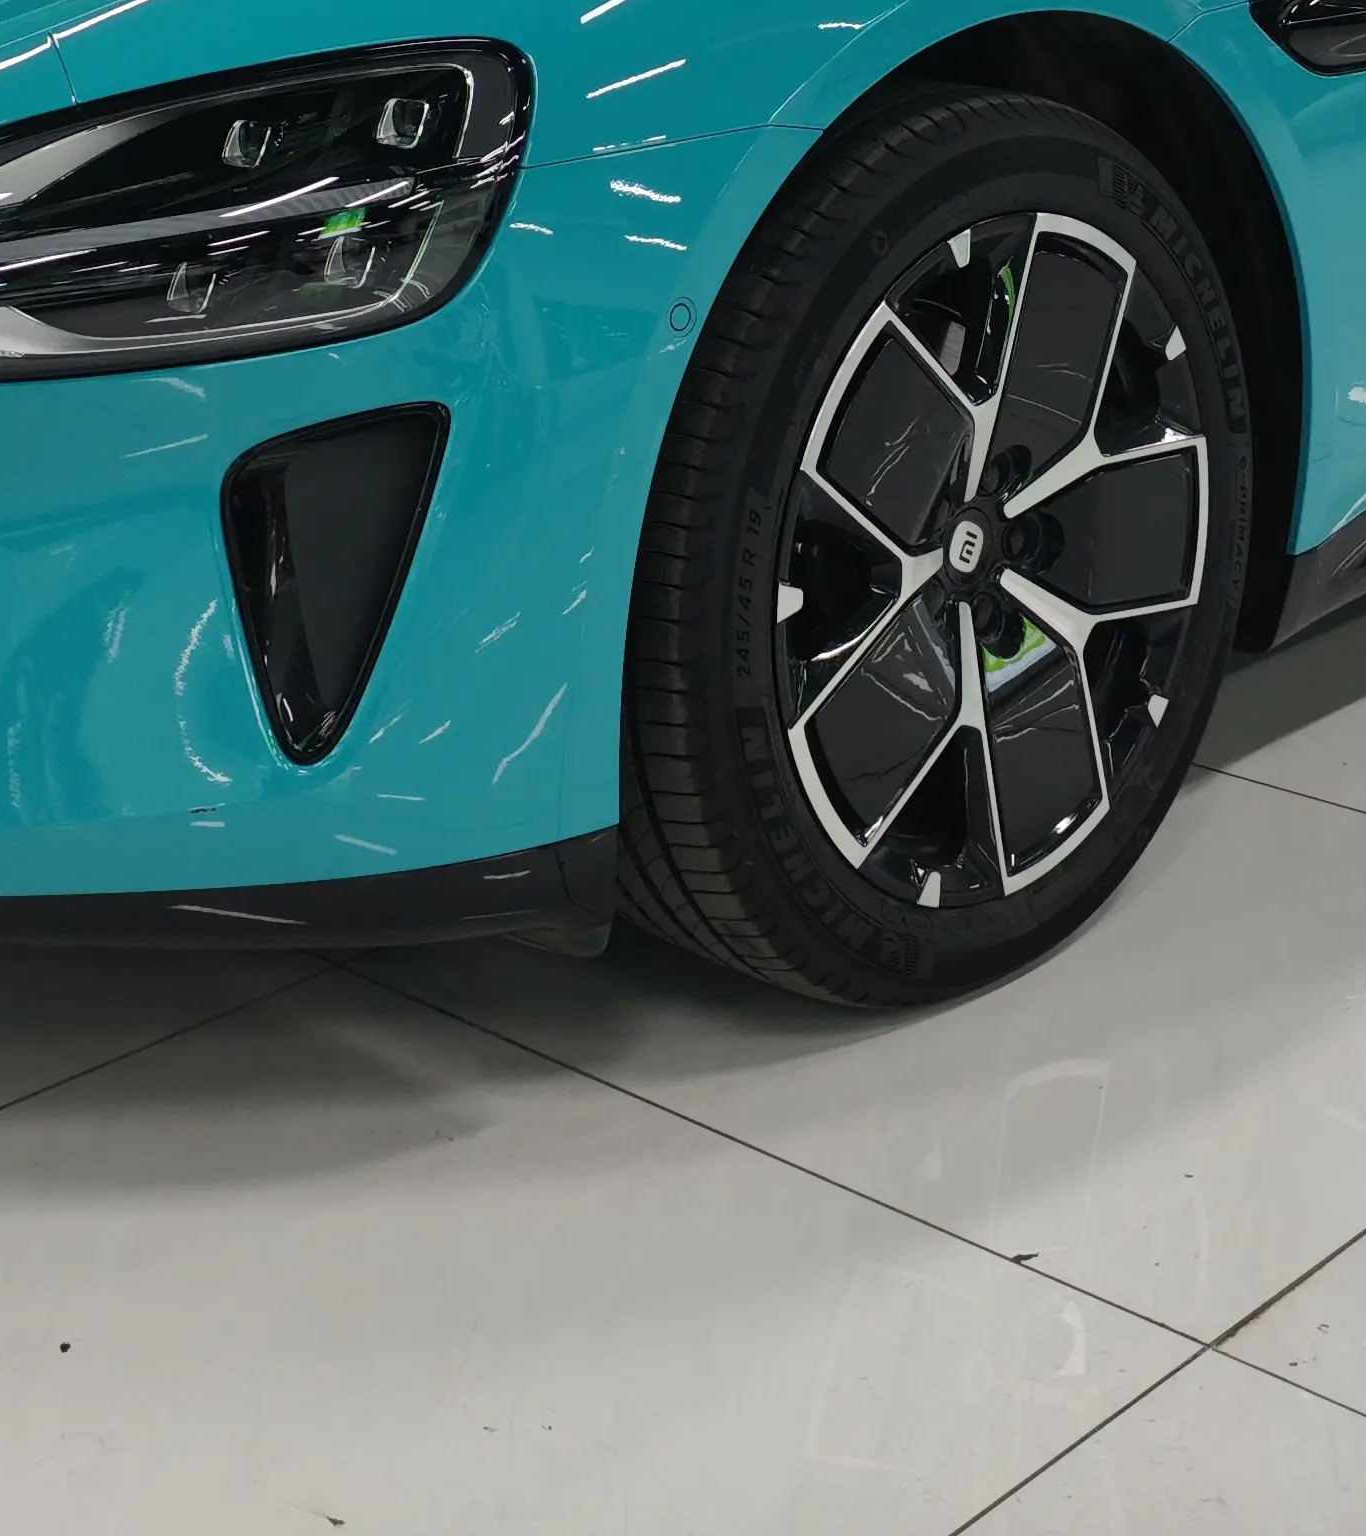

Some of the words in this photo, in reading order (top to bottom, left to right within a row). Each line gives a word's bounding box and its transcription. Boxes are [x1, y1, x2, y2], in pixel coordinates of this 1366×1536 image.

[1148, 204, 1248, 424] MICHELIN
[745, 508, 762, 537] 19
[741, 547, 758, 568] R
[736, 575, 754, 679] 245/45
